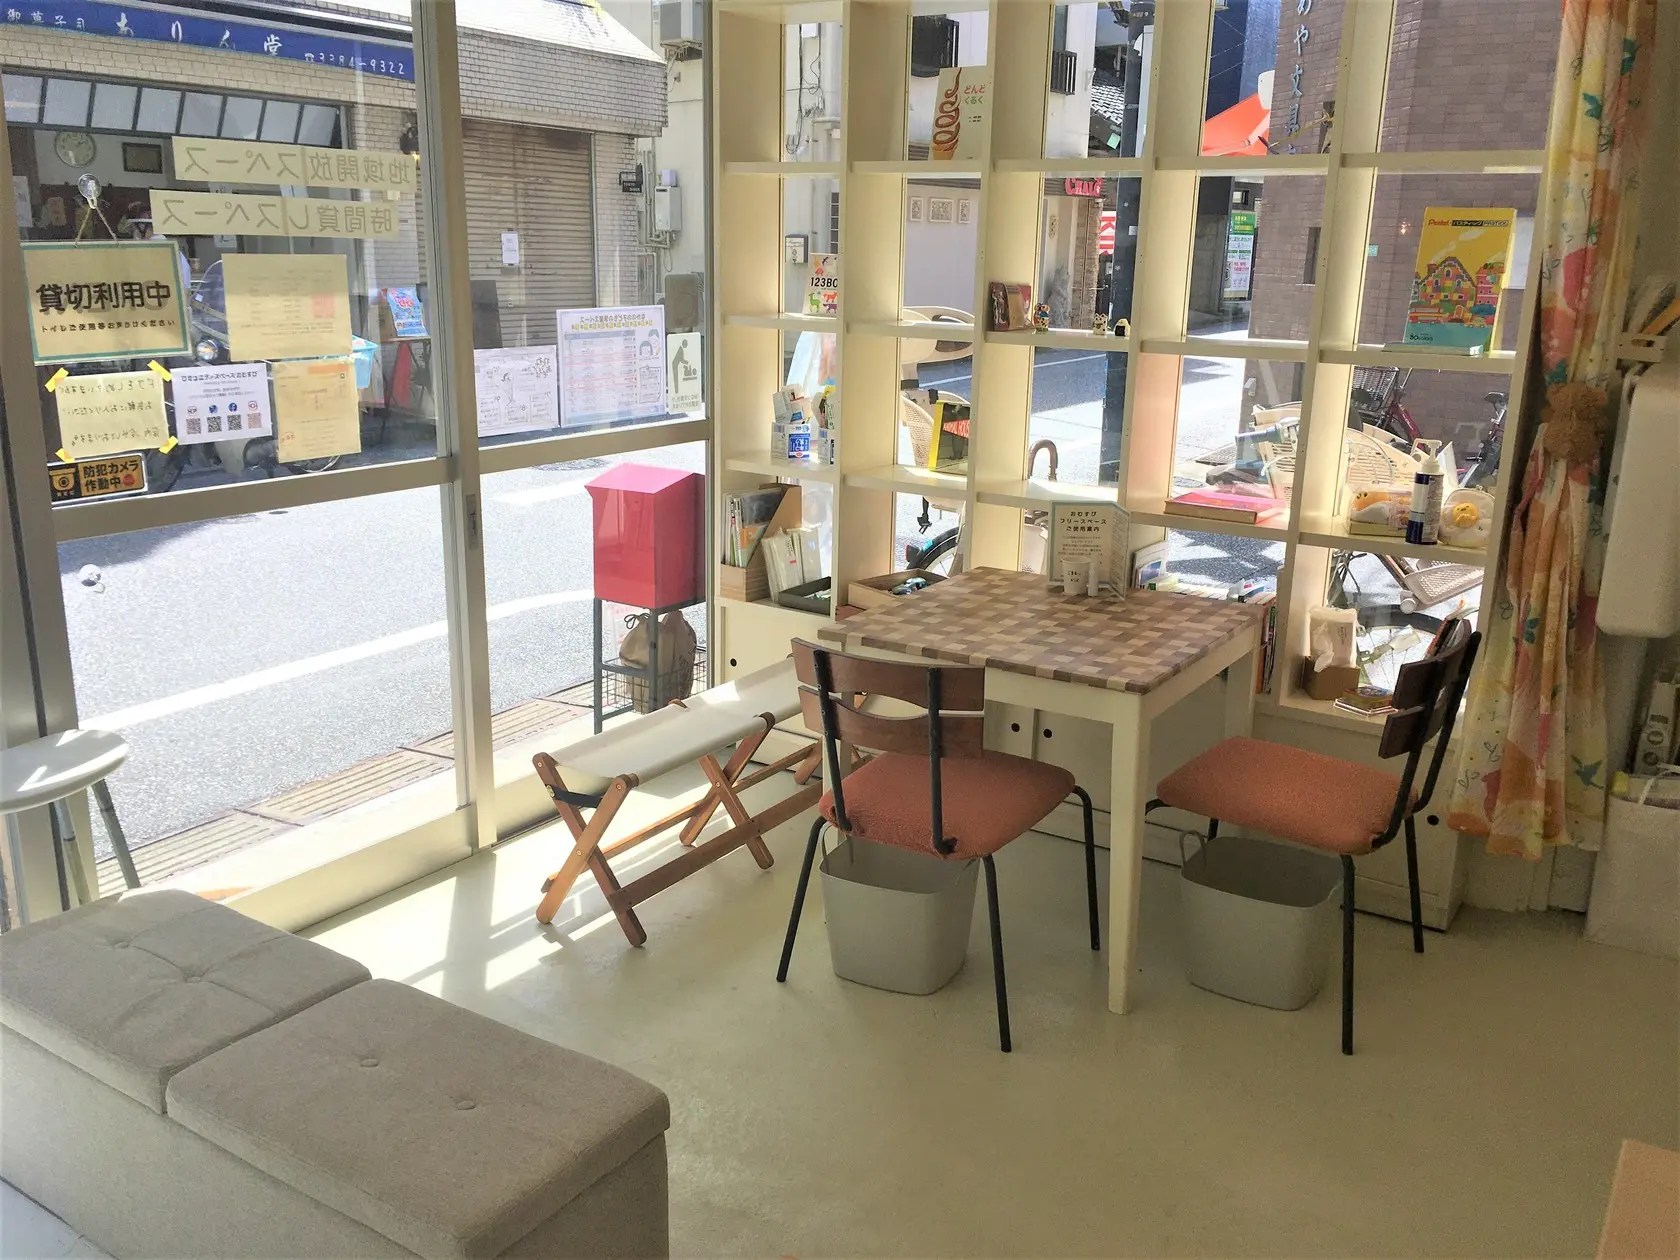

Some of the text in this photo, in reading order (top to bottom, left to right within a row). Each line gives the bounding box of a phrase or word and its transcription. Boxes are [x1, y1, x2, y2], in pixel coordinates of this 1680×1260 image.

[36, 280, 171, 313] 貸切利用中
[83, 460, 139, 478] 防犯カメラ
[85, 476, 121, 492] 作動中
